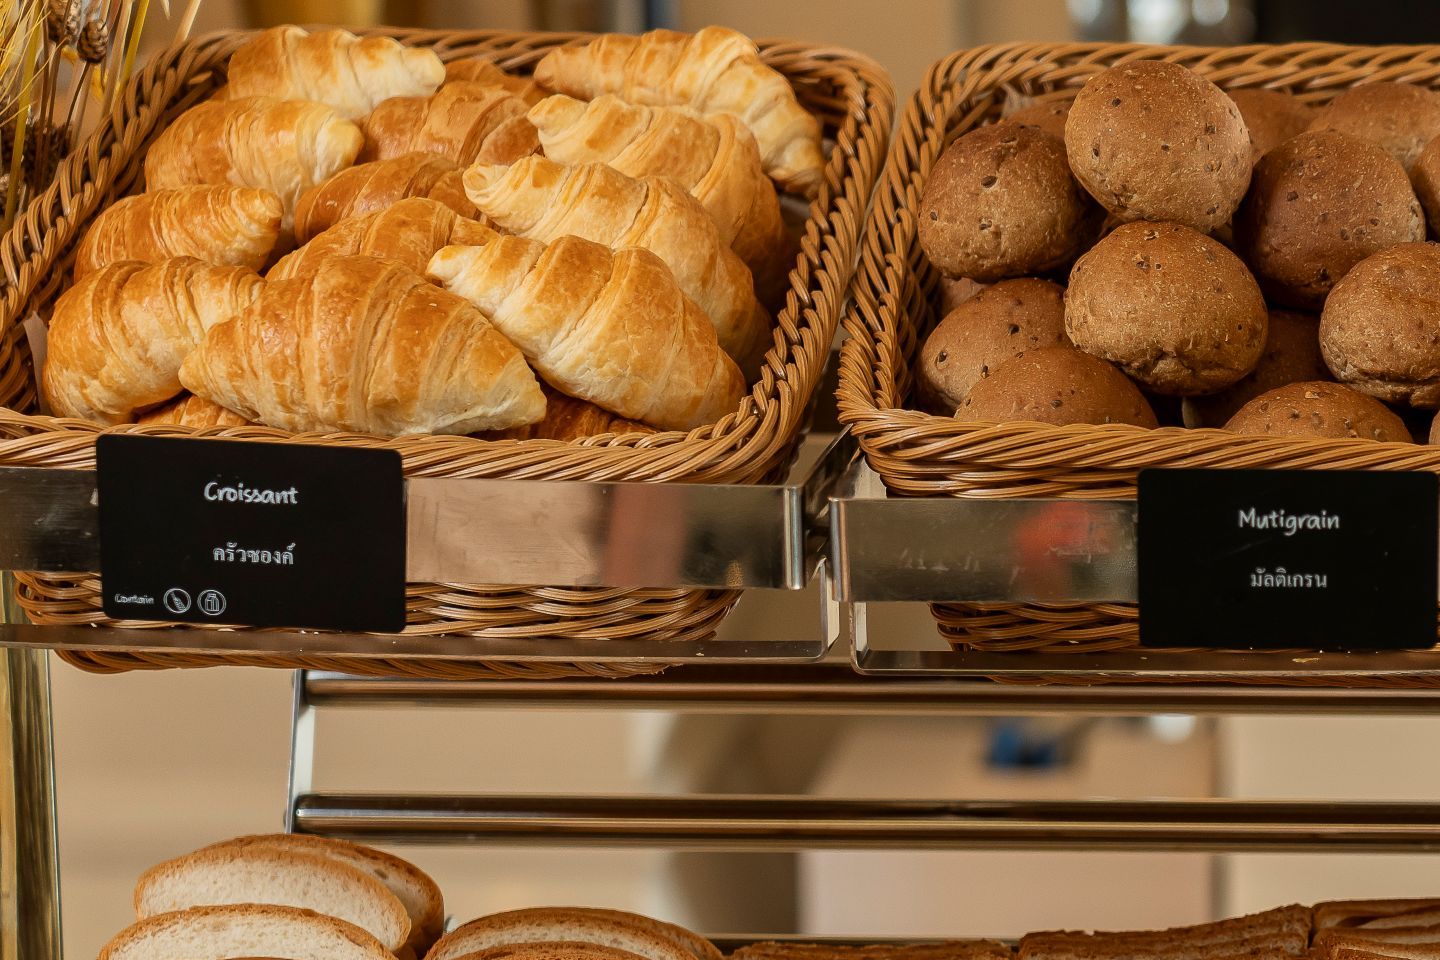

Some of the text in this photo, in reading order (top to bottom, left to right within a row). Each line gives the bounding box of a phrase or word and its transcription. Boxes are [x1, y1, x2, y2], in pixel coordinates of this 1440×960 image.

[203, 481, 299, 505] Croissant
[1238, 507, 1340, 536] Mutigrain
[1250, 566, 1328, 588] มัลติเกรน
